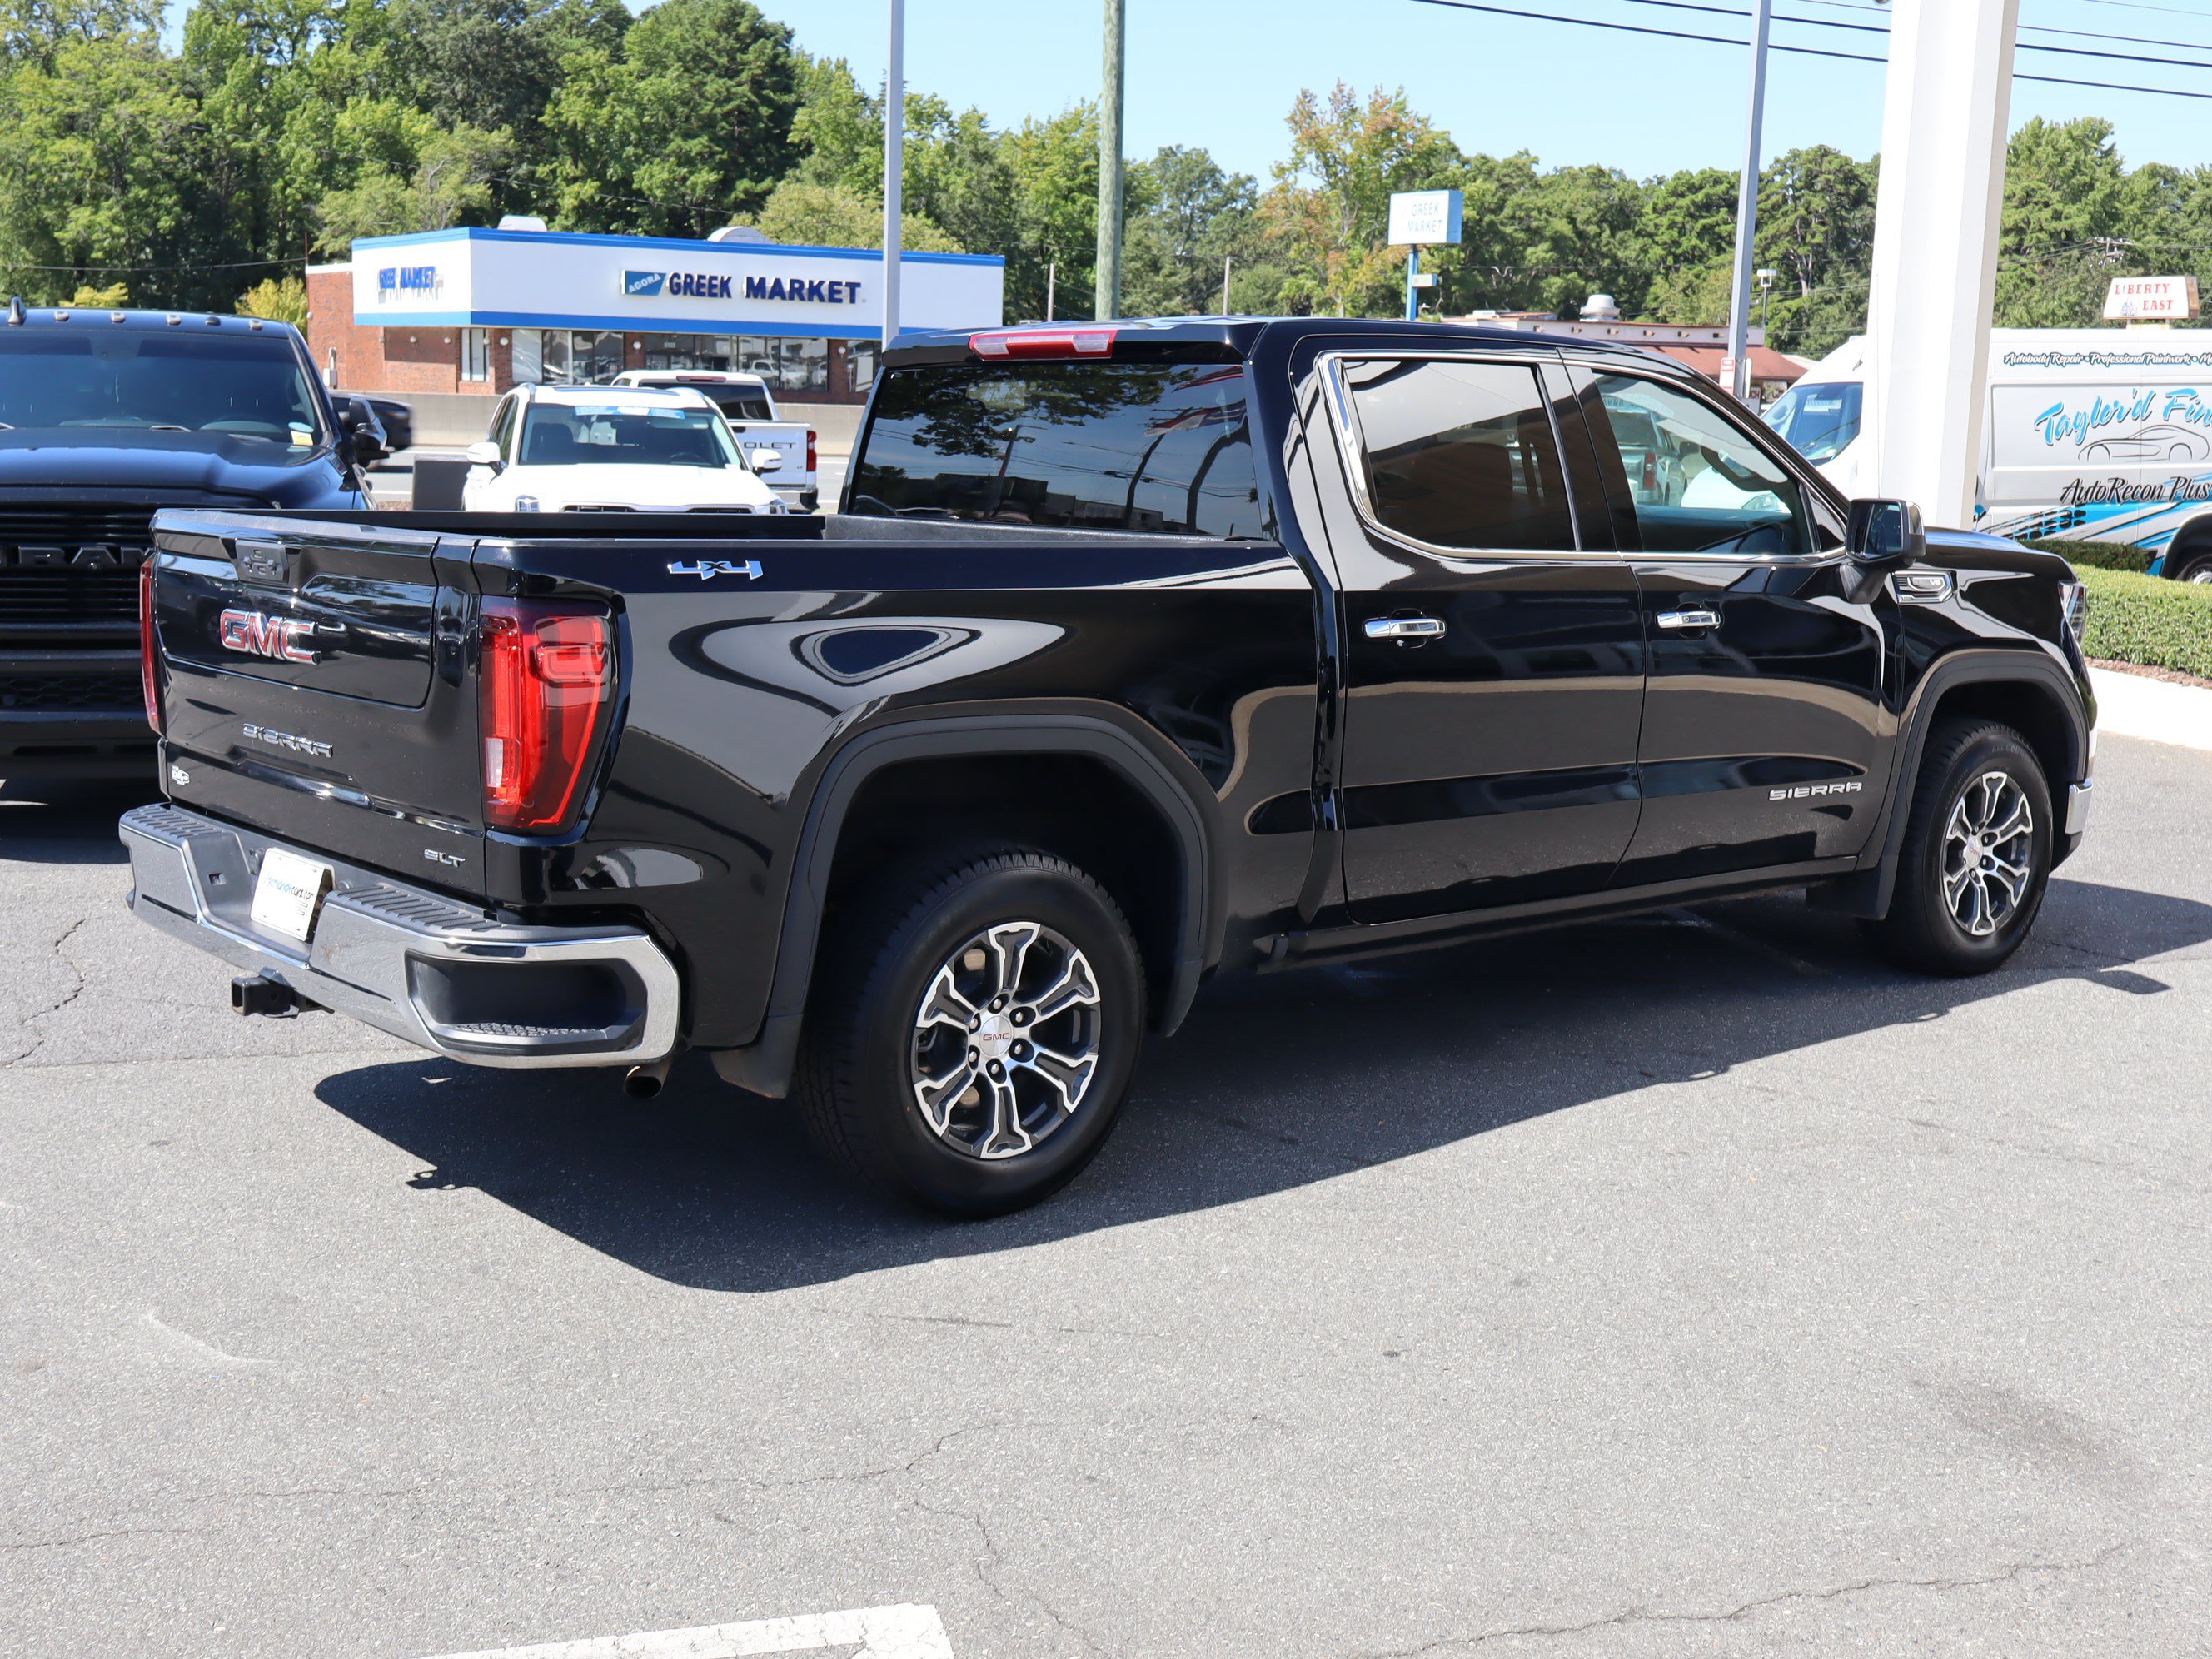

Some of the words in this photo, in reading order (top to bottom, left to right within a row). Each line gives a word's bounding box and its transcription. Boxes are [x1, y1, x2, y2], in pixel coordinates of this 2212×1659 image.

[628, 272, 661, 294] AGORA
[669, 272, 732, 299] GREEK
[745, 276, 862, 304] MARKET
[2115, 283, 2170, 295] LIBERTY
[2143, 299, 2174, 311] EAST
[2004, 351, 2050, 366] Autobody
[2050, 351, 2085, 367] Repair
[2090, 352, 2145, 367] Professional
[2143, 351, 2191, 366] Paintwork
[2034, 387, 2156, 446] Taylor'd
[2163, 388, 2212, 427] Fin
[2169, 476, 2209, 502] Plus
[220, 608, 321, 665] GMC
[242, 723, 333, 759] SIERRA
[1769, 781, 1863, 801] SIERRA
[424, 849, 466, 867] SLT
[983, 1032, 1010, 1041] GMC
